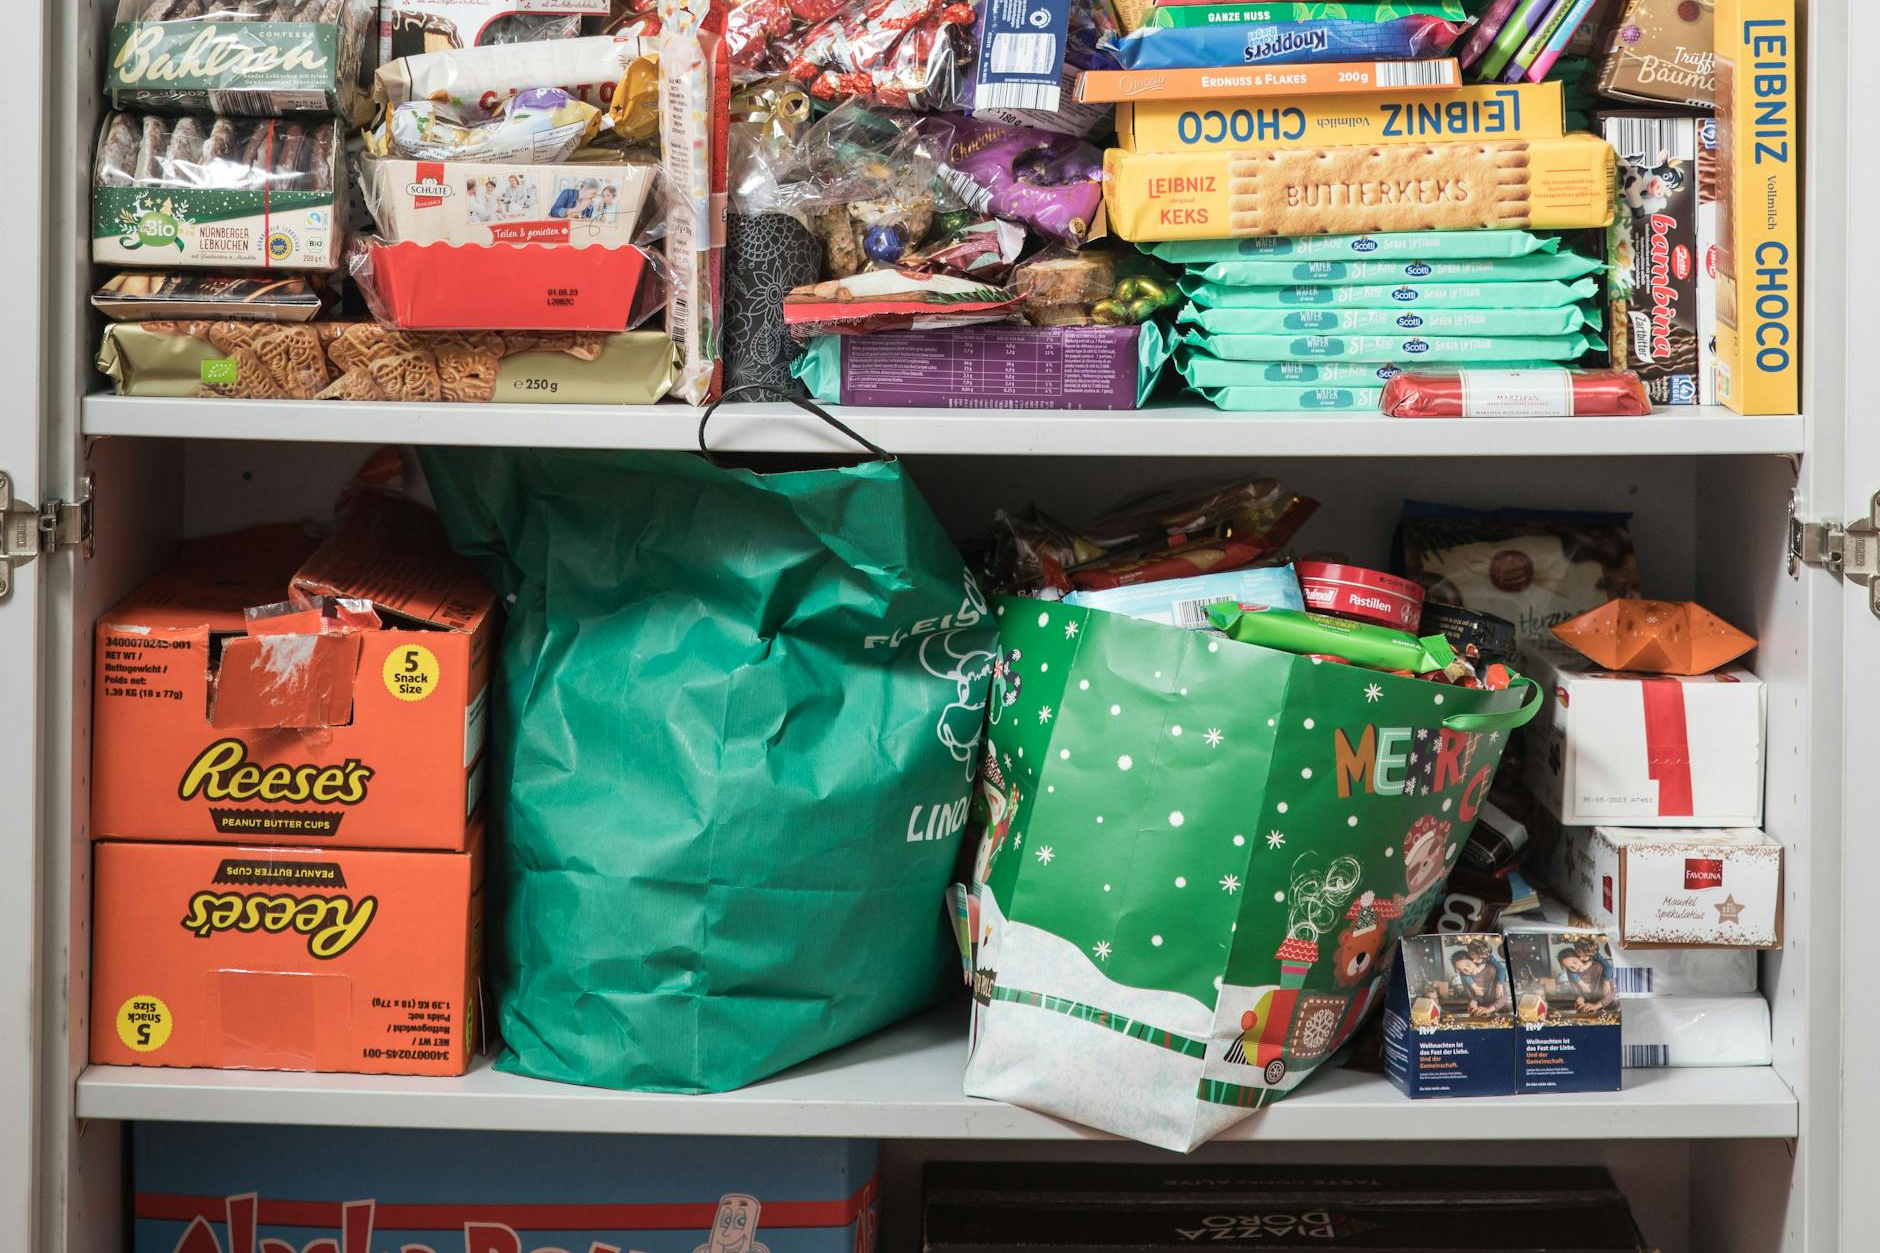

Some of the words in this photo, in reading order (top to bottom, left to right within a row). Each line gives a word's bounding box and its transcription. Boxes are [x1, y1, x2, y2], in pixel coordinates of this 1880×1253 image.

[1207, 12, 1241, 23] GANZE
[1243, 11, 1270, 22] NUSS
[1244, 29, 1328, 62] Knoppers
[114, 25, 328, 84] Bahlsen
[1202, 75, 1250, 88] ERDNUSS
[1254, 74, 1263, 86] &
[1265, 73, 1307, 85] FLAKES
[1743, 19, 1788, 165] LEIBNIZ
[1000, 112, 1015, 124] 180
[1382, 90, 1521, 135] LEIBNIZ
[1178, 107, 1307, 145] CHOCO
[1317, 117, 1370, 130] Vollmilch
[411, 185, 448, 195] SCHULTE
[1148, 176, 1217, 200] LEIBNIZ
[1285, 177, 1471, 208] BUTTERKEKS
[1766, 174, 1776, 231] Vollmilch
[1159, 208, 1209, 226] KEKS
[152, 220, 175, 237] Bio
[199, 226, 249, 239] NÜRNBERGER
[493, 229, 517, 239] Teilen
[527, 227, 559, 241] genießen
[199, 239, 249, 251] LEBKUCHEN
[1353, 241, 1376, 251] Scotti
[1407, 266, 1430, 276] Scotti
[1650, 213, 1679, 358] bambina
[1393, 290, 1417, 300] Scotti
[1754, 241, 1790, 373] CHOCO
[1398, 317, 1422, 326] Scotti
[1634, 316, 1648, 356] Zartbitter
[1404, 342, 1428, 352] Scotti
[525, 378, 548, 392] 250
[550, 381, 558, 393] g
[1672, 377, 1681, 403] RIEGEL
[1350, 594, 1391, 612] Pastillen
[105, 652, 121, 661] NET
[123, 652, 137, 661] WT
[404, 651, 419, 673] 5
[105, 663, 161, 675] Nettogewicht
[105, 676, 127, 685] Poids
[129, 676, 146, 685] net:
[394, 673, 428, 684] Snack
[105, 688, 121, 698] 1.39
[162, 689, 183, 701] 77g)
[399, 684, 422, 694] Size
[1334, 723, 1483, 799] MERRY
[181, 739, 374, 804] Reese's
[222, 818, 262, 829] PEANUT
[263, 819, 302, 829] BUTTER
[304, 819, 330, 830] CUPS
[227, 866, 252, 877] CUPS
[254, 867, 293, 877] BUTTER
[295, 868, 334, 879] PEANUT
[1686, 870, 1721, 881] FAVORINA
[1662, 896, 1697, 907] Mandel
[1655, 908, 1705, 920] Spekulatius
[182, 891, 377, 959] Reese's
[133, 1001, 157, 1013] Size
[128, 1012, 161, 1024] Snack
[429, 1011, 450, 1022] Poids
[136, 1023, 150, 1044] 5
[394, 1022, 450, 1034] Nettogewicht
[434, 1037, 449, 1046] NET
[1176, 1223, 1334, 1240] PIAZZA
